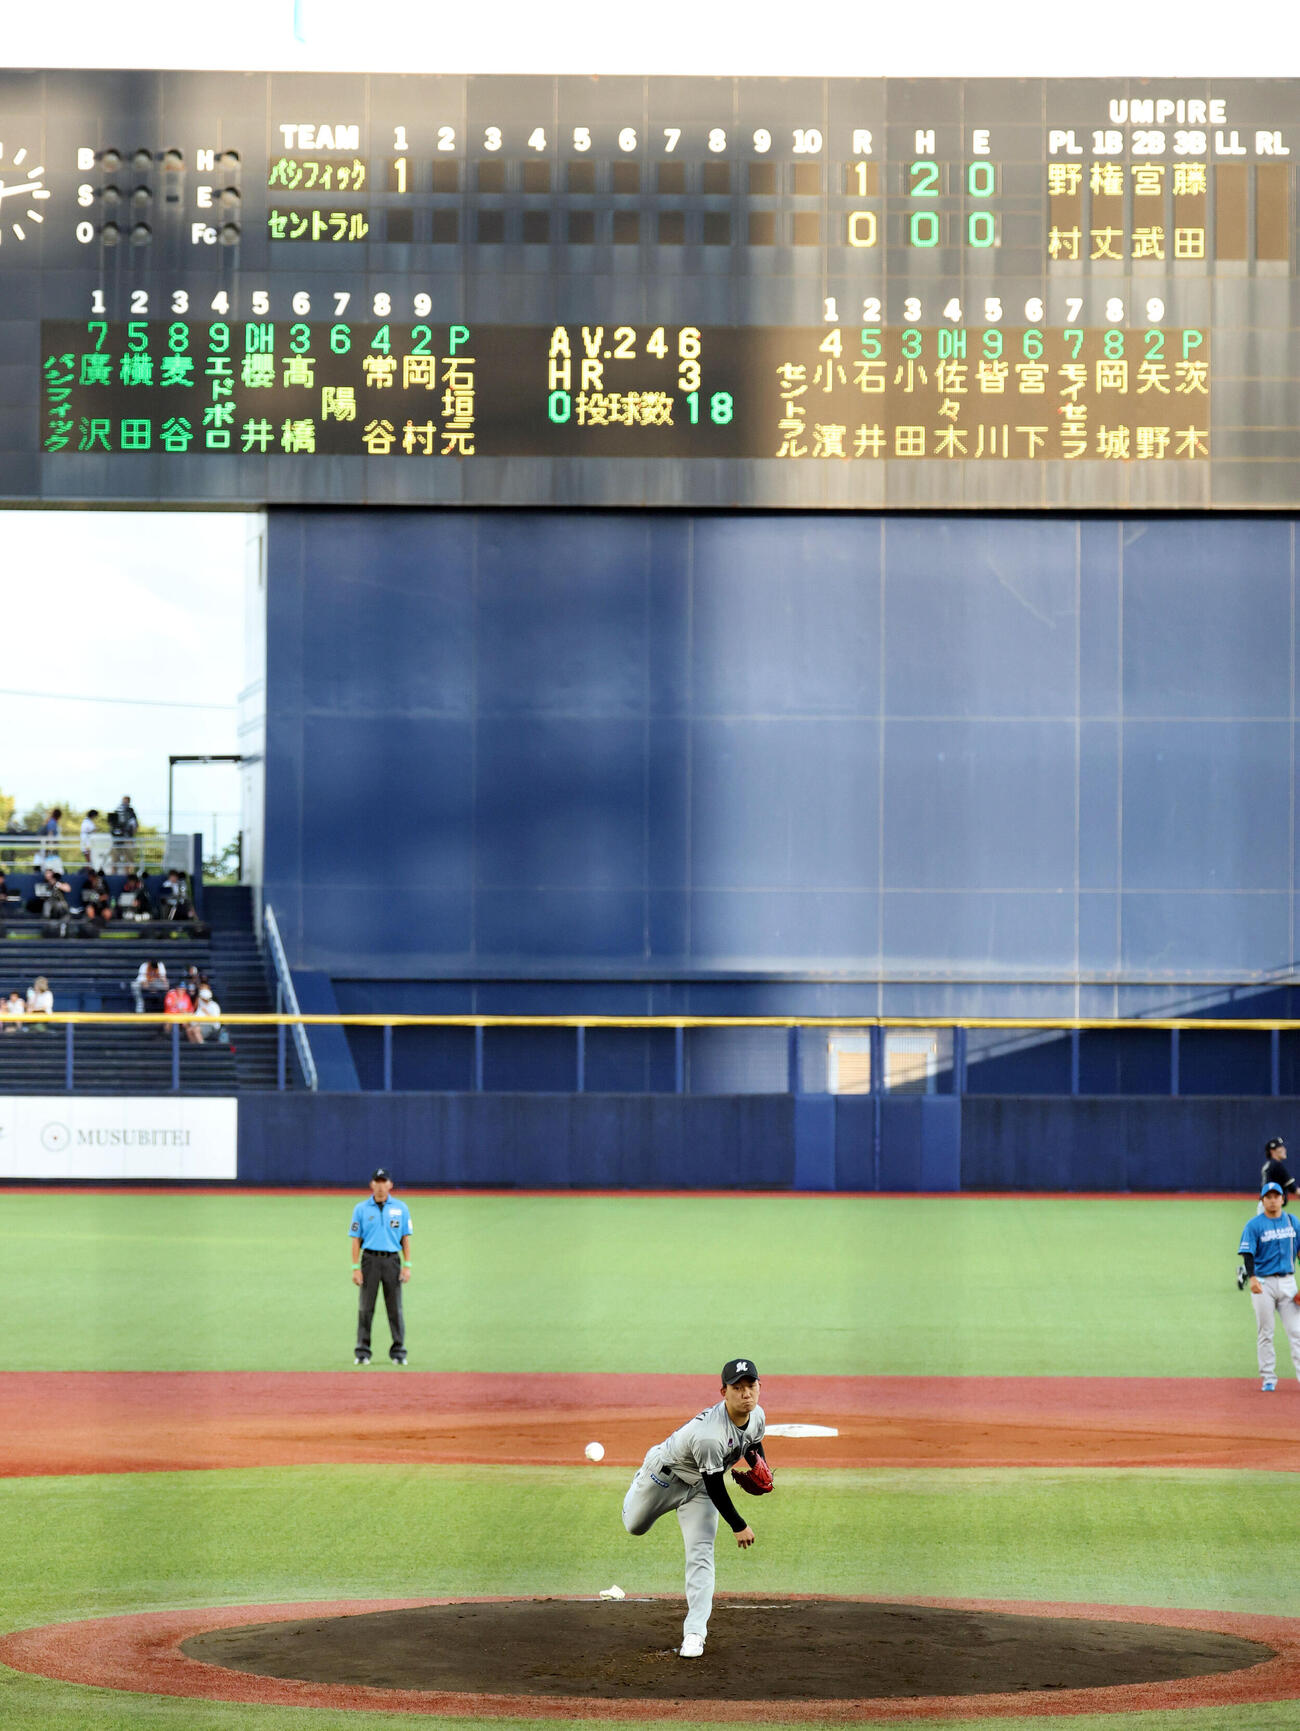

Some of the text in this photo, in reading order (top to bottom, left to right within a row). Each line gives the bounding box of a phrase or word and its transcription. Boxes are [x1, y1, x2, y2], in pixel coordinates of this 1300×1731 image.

[1108, 98, 1227, 126] UMPIRE
[279, 123, 991, 155] TEAM 1 2 3 4 5 6 7 8 9 10 R H E
[1048, 129, 1290, 156] PL 1B 2B 3B LL RL
[77, 147, 95, 171] B
[196, 149, 215, 172] H
[268, 157, 995, 198] パシフィック 1 1 2 0
[77, 183, 94, 207] S
[196, 185, 213, 209] E
[267, 209, 995, 248] セントラル 0 0 0
[91, 289, 432, 317] 1 2 3 4 5 6 7 8 9
[823, 297, 1165, 323] 1 2 3 4 5 6 7 8 9
[87, 321, 470, 357] 7 5 8 9 DH 3 6 4 2 P
[818, 328, 1203, 360] 4 5 3 DH 9 6 7 8 2 P
[548, 358, 701, 394] HR 3
[321, 386, 356, 422] 陽
[548, 390, 571, 424] 0
[575, 390, 674, 426] 投球数
[77, 1129, 191, 1147] MUSUBITEI
